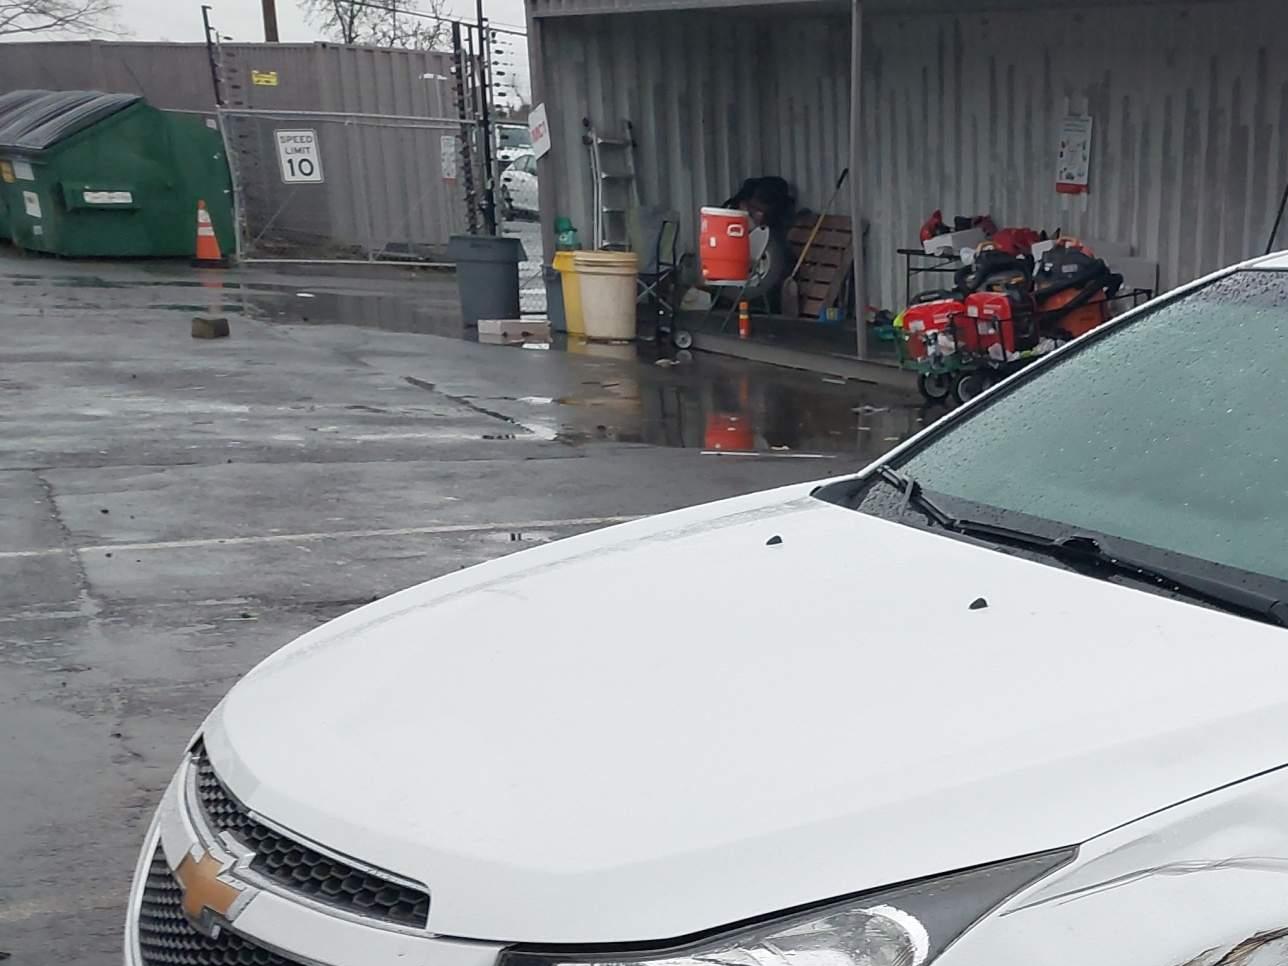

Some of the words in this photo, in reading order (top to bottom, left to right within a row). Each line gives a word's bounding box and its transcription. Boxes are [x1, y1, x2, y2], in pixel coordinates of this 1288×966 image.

[280, 135, 313, 144] SPEED
[285, 146, 311, 155] LIMIT
[287, 158, 314, 177] 10
